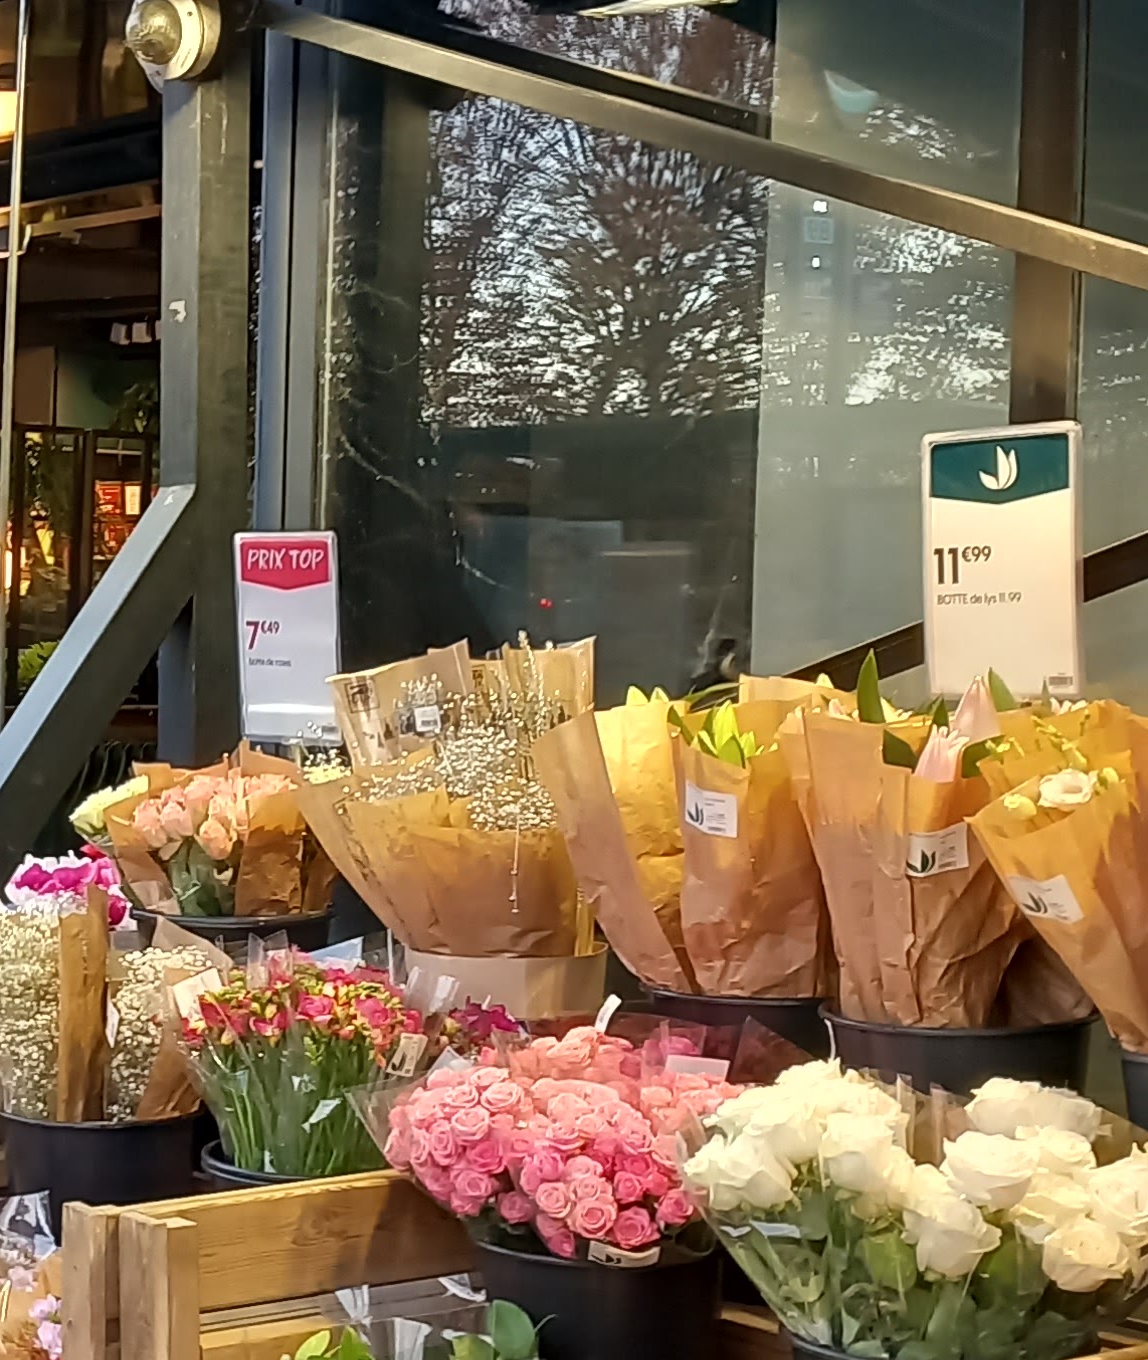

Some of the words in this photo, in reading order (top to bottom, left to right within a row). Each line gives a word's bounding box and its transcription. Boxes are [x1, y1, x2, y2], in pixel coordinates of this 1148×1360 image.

[247, 547, 285, 570] PRIX
[289, 548, 324, 570] TOP
[937, 593, 968, 606] BOTTE
[970, 593, 982, 605] de
[984, 592, 997, 606] lys
